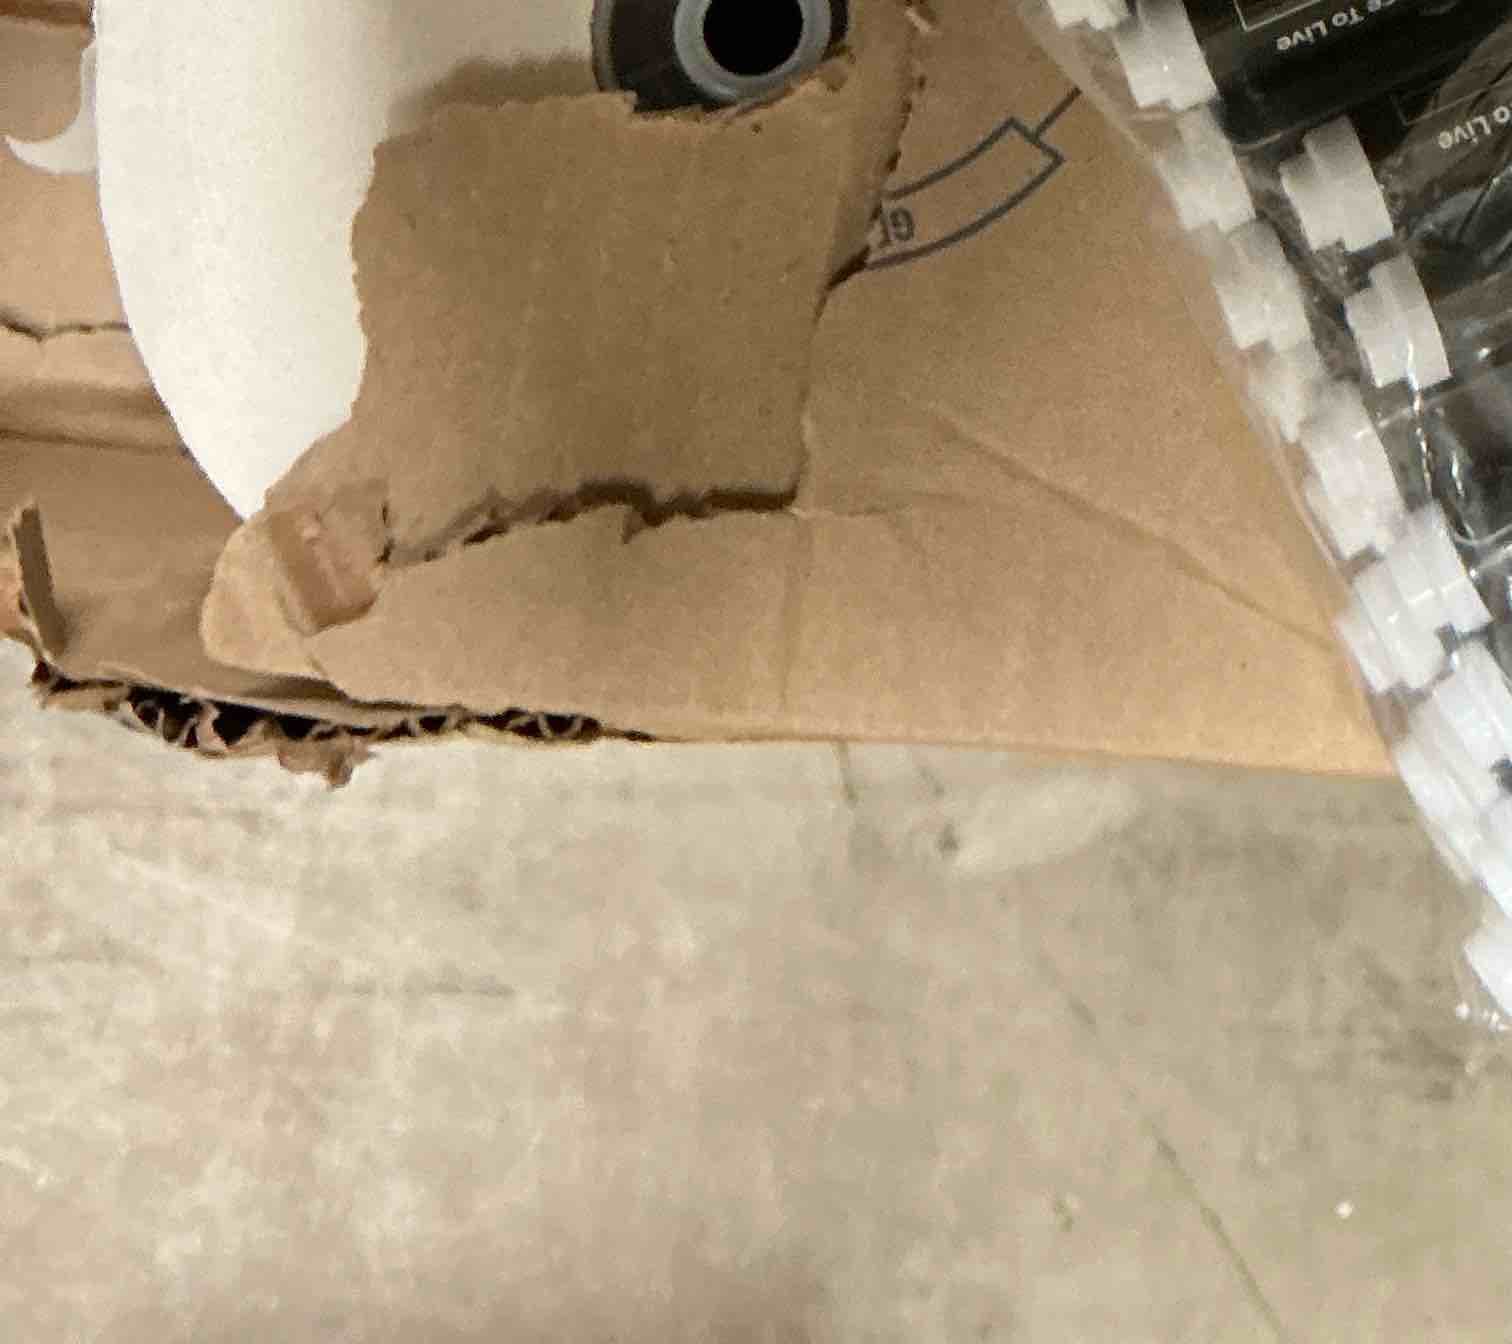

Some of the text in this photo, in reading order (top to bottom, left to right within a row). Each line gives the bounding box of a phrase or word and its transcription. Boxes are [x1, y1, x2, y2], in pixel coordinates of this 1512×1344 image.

[1331, 7, 1365, 27] To
[1276, 19, 1328, 51] Live
[1437, 117, 1492, 152] Live
